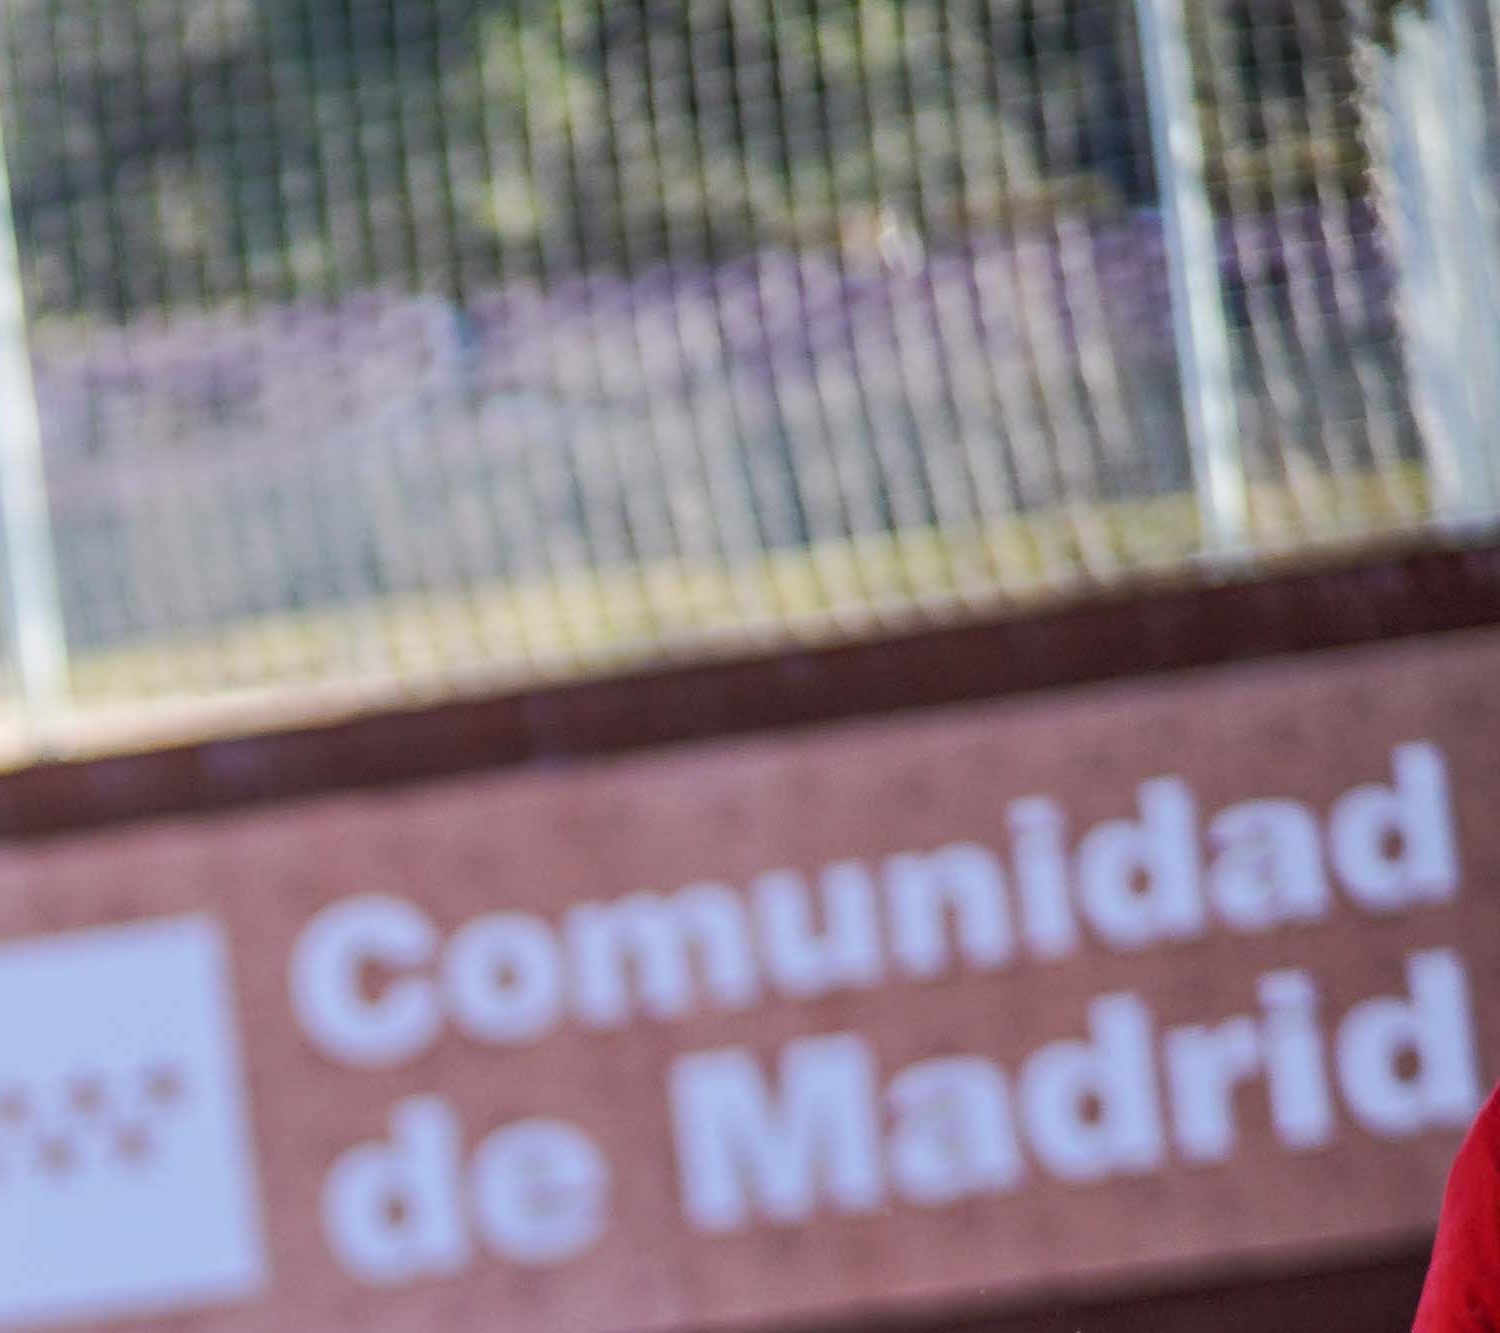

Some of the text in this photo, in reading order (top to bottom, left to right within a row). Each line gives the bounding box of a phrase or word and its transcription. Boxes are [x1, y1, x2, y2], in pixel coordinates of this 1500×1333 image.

[290, 740, 1458, 1066] Comunidad
[322, 948, 1478, 1287] de Madrid
